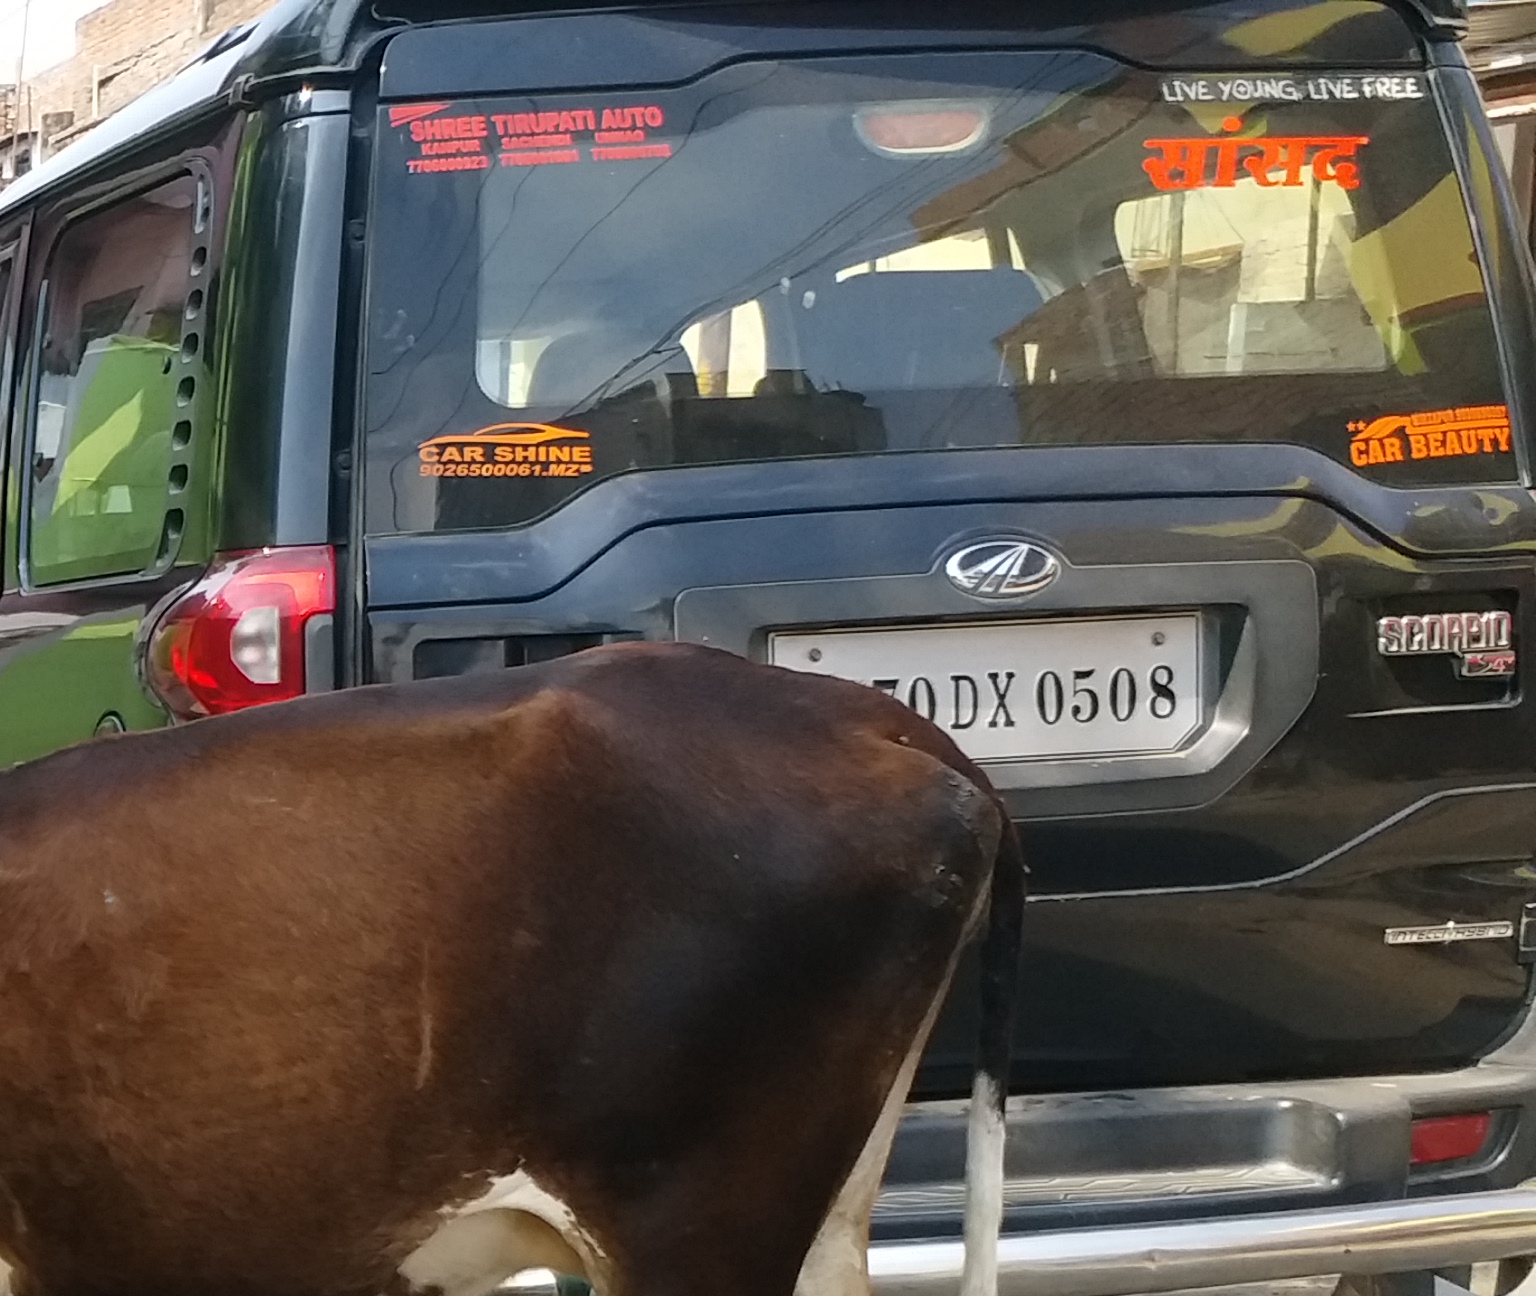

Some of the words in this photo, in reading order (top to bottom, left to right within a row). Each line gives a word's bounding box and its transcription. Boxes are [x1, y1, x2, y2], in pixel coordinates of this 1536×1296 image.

[1161, 80, 1212, 101] LIVE
[1306, 78, 1359, 100] LIVE
[1361, 76, 1425, 100] FREE
[411, 116, 487, 142] SHREE
[491, 110, 595, 134] TIRUPATI
[602, 106, 664, 128] AUTO
[1141, 116, 1370, 191] सांसद
[418, 446, 485, 462] CAR
[493, 445, 592, 462] SHINE
[1350, 435, 1405, 467] CAR
[1409, 427, 1511, 460] BEAUTY
[1036, 664, 1177, 725] 0508
